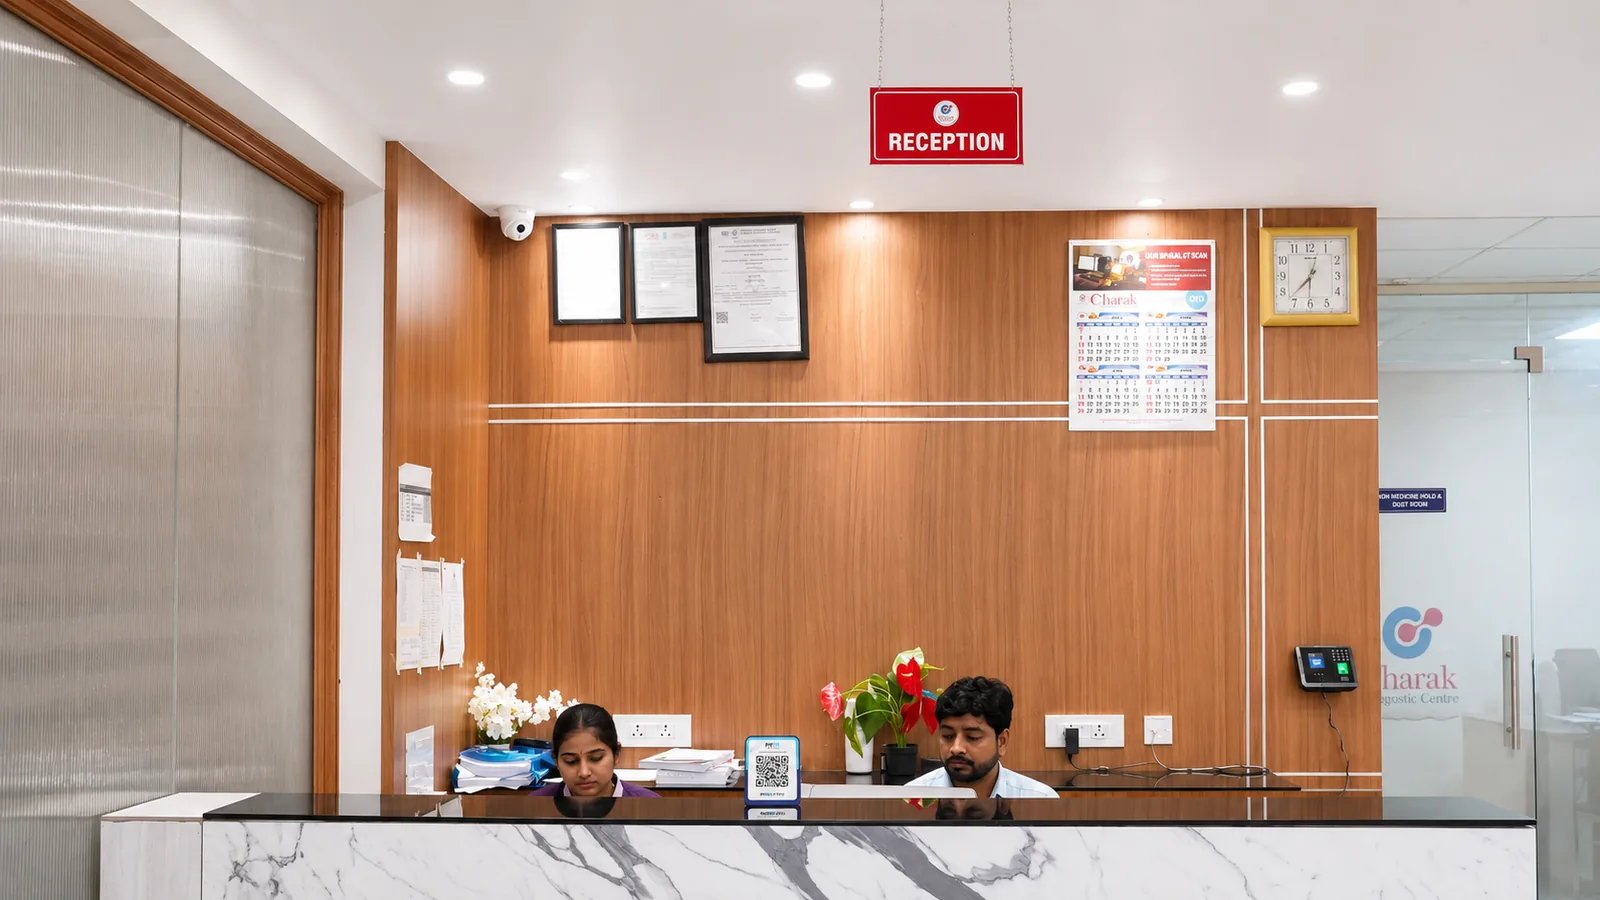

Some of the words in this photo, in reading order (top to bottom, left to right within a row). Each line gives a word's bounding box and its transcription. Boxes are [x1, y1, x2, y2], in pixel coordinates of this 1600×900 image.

[888, 132, 1005, 151] RECEPTION
[1290, 243, 1298, 253] 11
[1305, 243, 1315, 253] 12
[1324, 243, 1328, 253] 1
[1278, 255, 1287, 265] 10
[1334, 255, 1341, 265] 2
[1279, 271, 1286, 281] 9
[1334, 271, 1341, 281] 3
[1279, 287, 1286, 296] 8
[1334, 287, 1341, 296] 4
[1090, 293, 1137, 305] Charak
[1291, 298, 1297, 308] 7
[1307, 298, 1313, 309] 6
[1324, 298, 1330, 308] 5
[1381, 664, 1458, 690] harak
[1420, 692, 1459, 704] Centre
